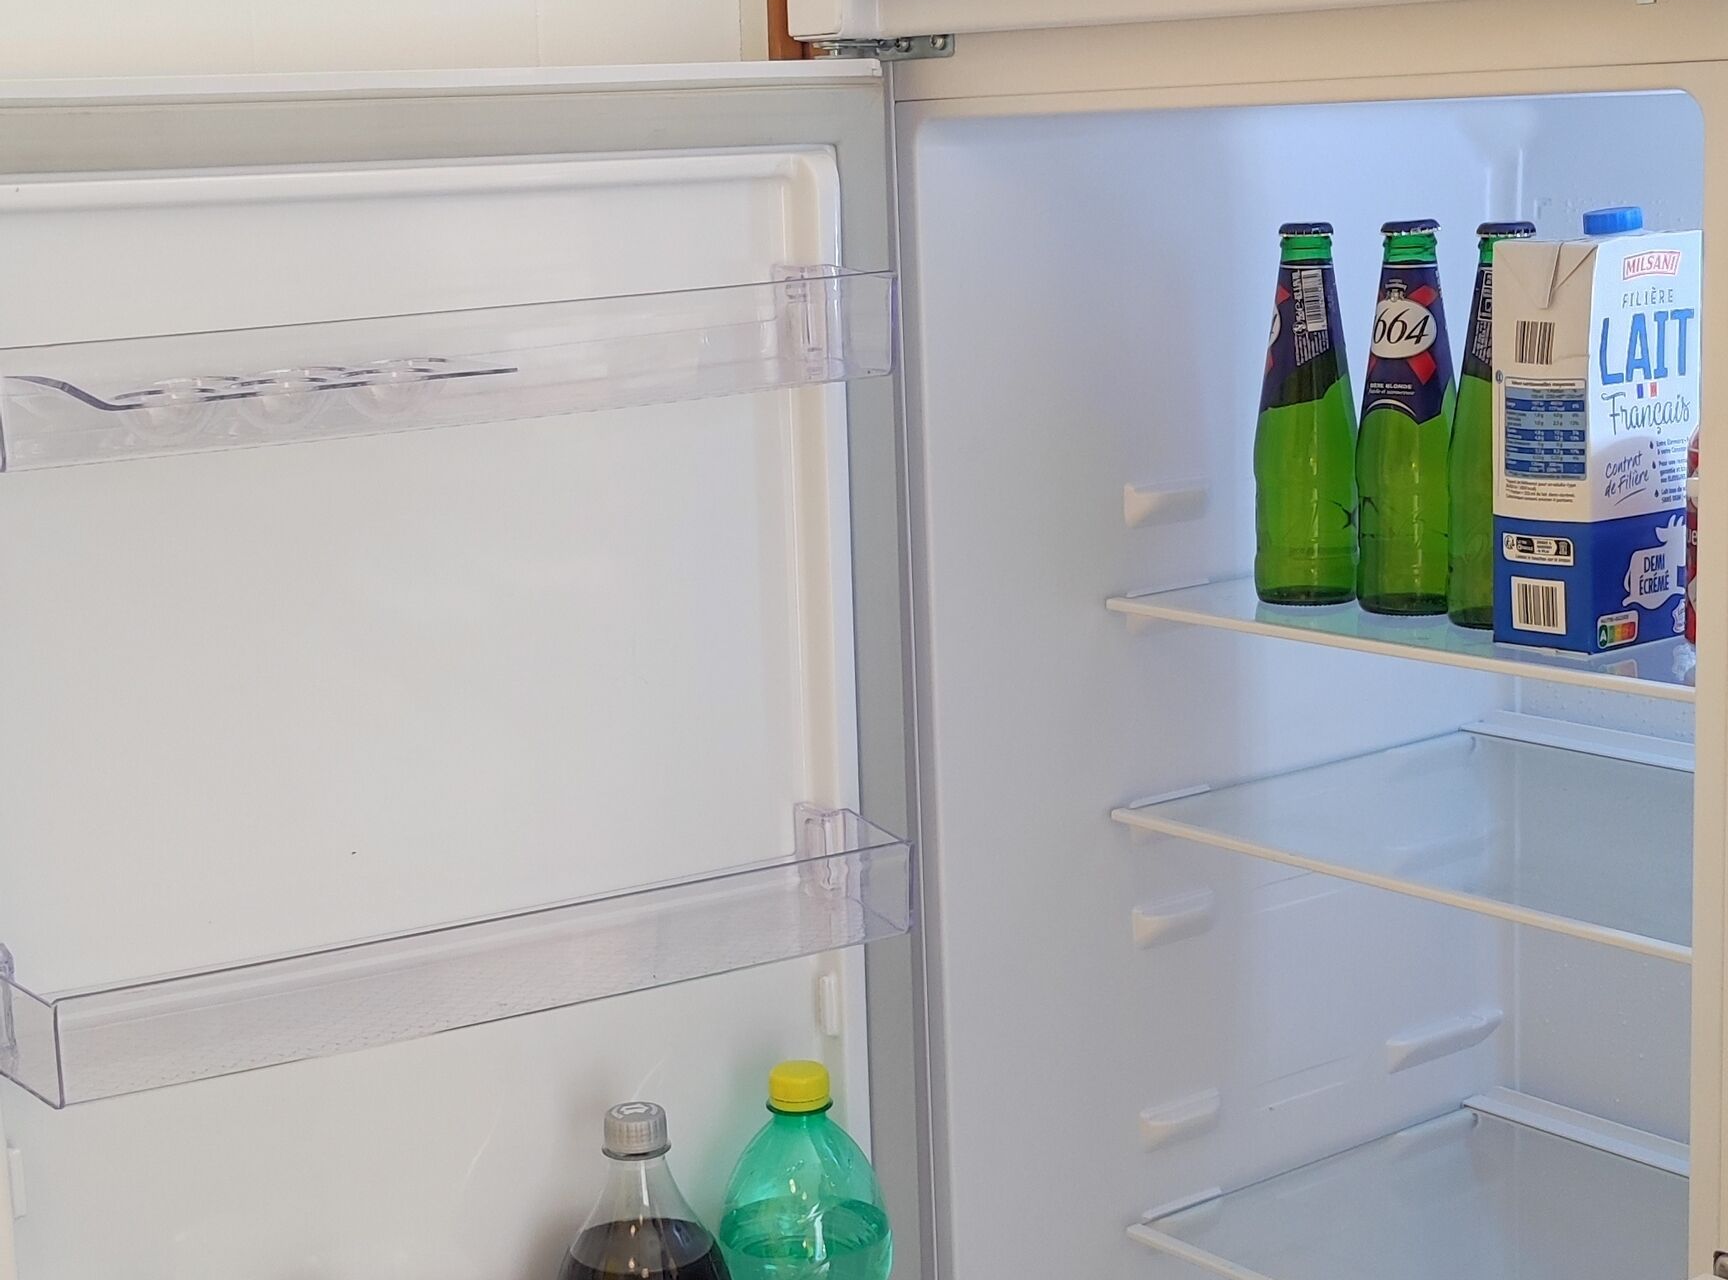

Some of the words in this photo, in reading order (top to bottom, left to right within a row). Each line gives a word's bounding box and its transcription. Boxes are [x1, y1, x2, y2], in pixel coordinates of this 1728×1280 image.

[1625, 254, 1677, 276] MILSANI
[1622, 286, 1674, 309] FILIÈRE
[1373, 307, 1430, 346] 664
[1599, 308, 1695, 386] LAIT
[1600, 392, 1691, 435] Français
[1604, 452, 1643, 478] Contrat
[1604, 481, 1616, 498] de
[1617, 469, 1650, 494] Filière
[1643, 553, 1666, 573] DEMI
[1638, 572, 1670, 596] ÉCRÉMÉ
